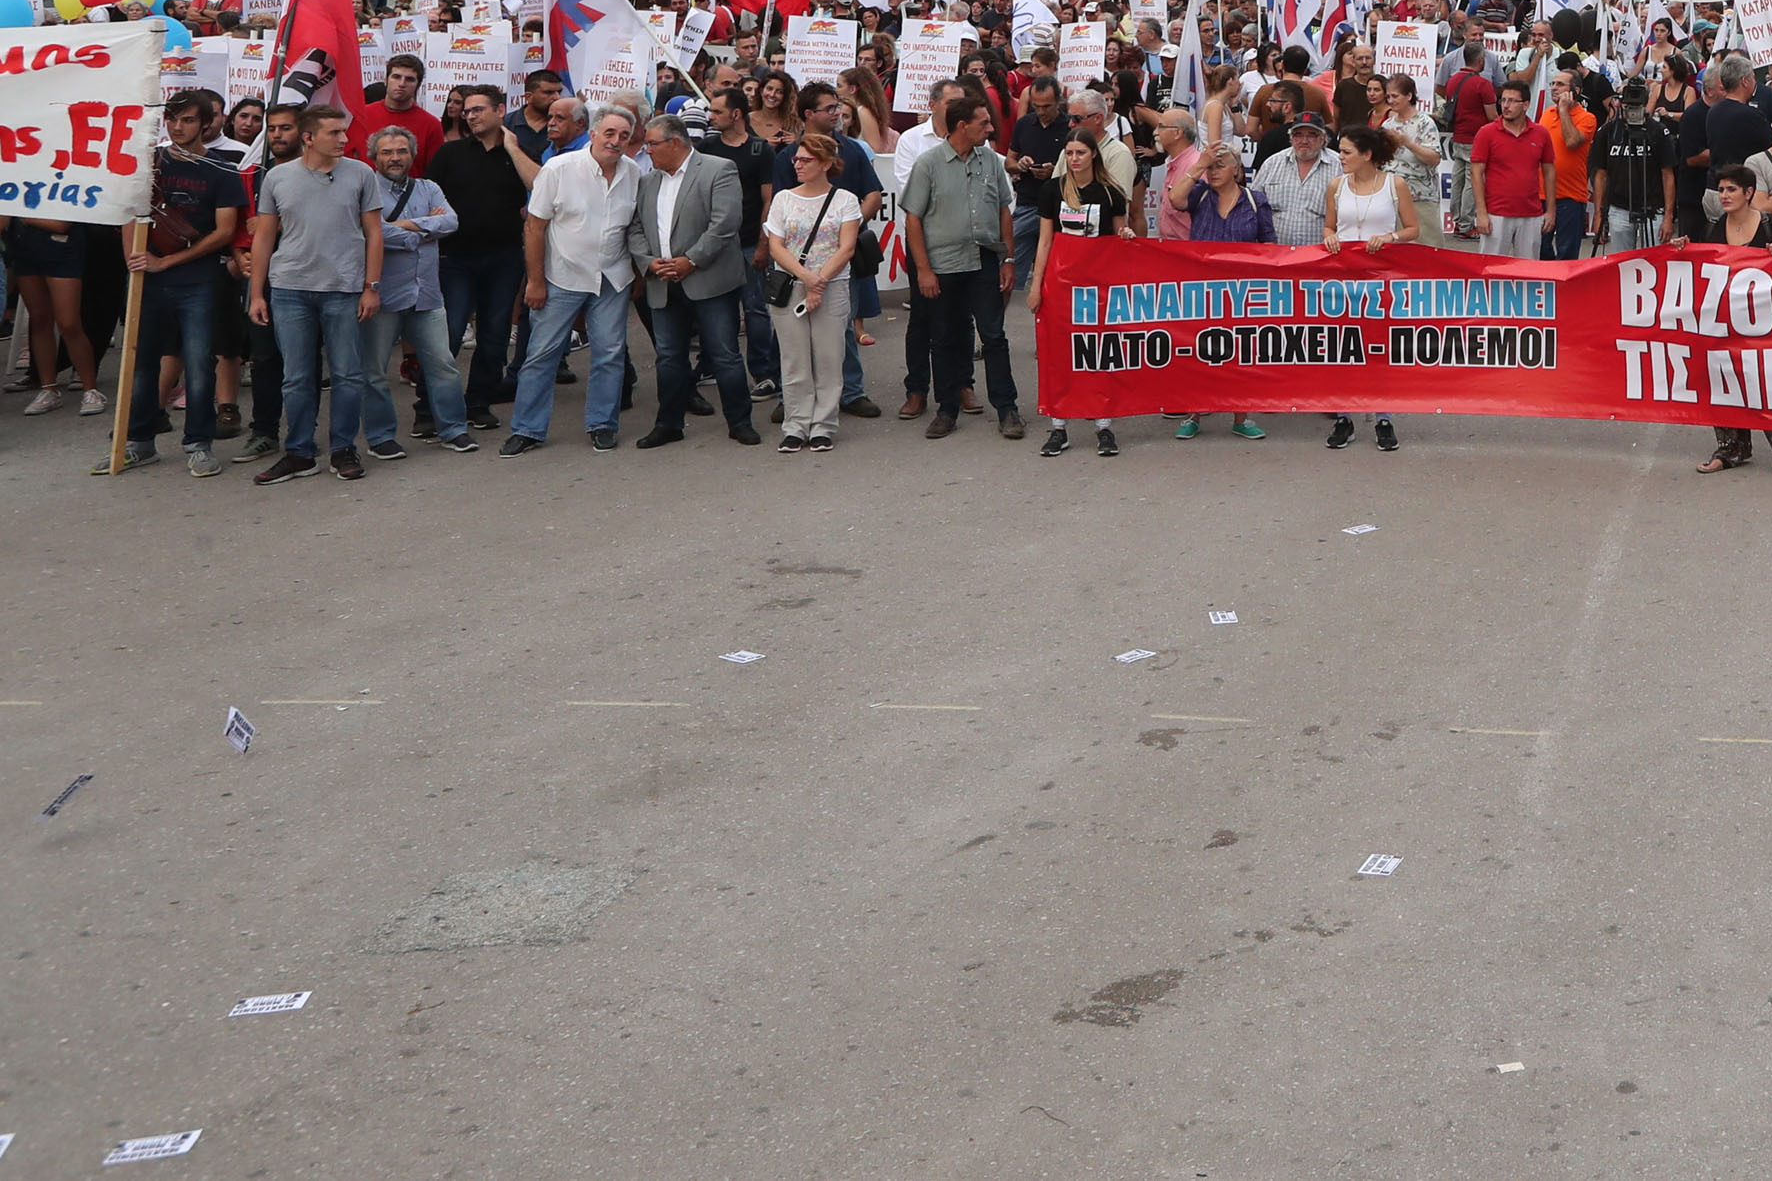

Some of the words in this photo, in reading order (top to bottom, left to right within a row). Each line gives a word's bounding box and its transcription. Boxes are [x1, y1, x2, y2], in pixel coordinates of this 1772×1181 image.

[249, 0, 282, 10] ΚΑΝΕΝΑ
[1746, 27, 1765, 41] ΤΟΥ
[1383, 45, 1427, 59] ΚΑΝΕΝΑ
[428, 60, 439, 69] ΟΙ
[440, 60, 505, 72] ΙΜΠΕΡΙΑΛΙΣΤΕΣ
[1380, 62, 1406, 77] ΣΠΙΤΙ
[1408, 62, 1429, 77] ΣΤΑ
[453, 72, 464, 82] ΤΗ
[466, 73, 478, 82] ΓΗ
[1072, 286, 1097, 324] Η
[1105, 279, 1293, 323] ΑΝΑΠΤΥΞΗ
[1300, 279, 1383, 318] ΤΟΥΣ
[1389, 280, 1557, 320] ΣΗΜΑΙΝΕΙ
[1072, 330, 1171, 372] ΝΑΤΟ
[1197, 325, 1365, 366] ΦΤΩΧΕΙΑ
[1389, 326, 1557, 370] ΠΟΛΕΜΟΙ
[1616, 339, 1698, 403] ΤΙΣ
